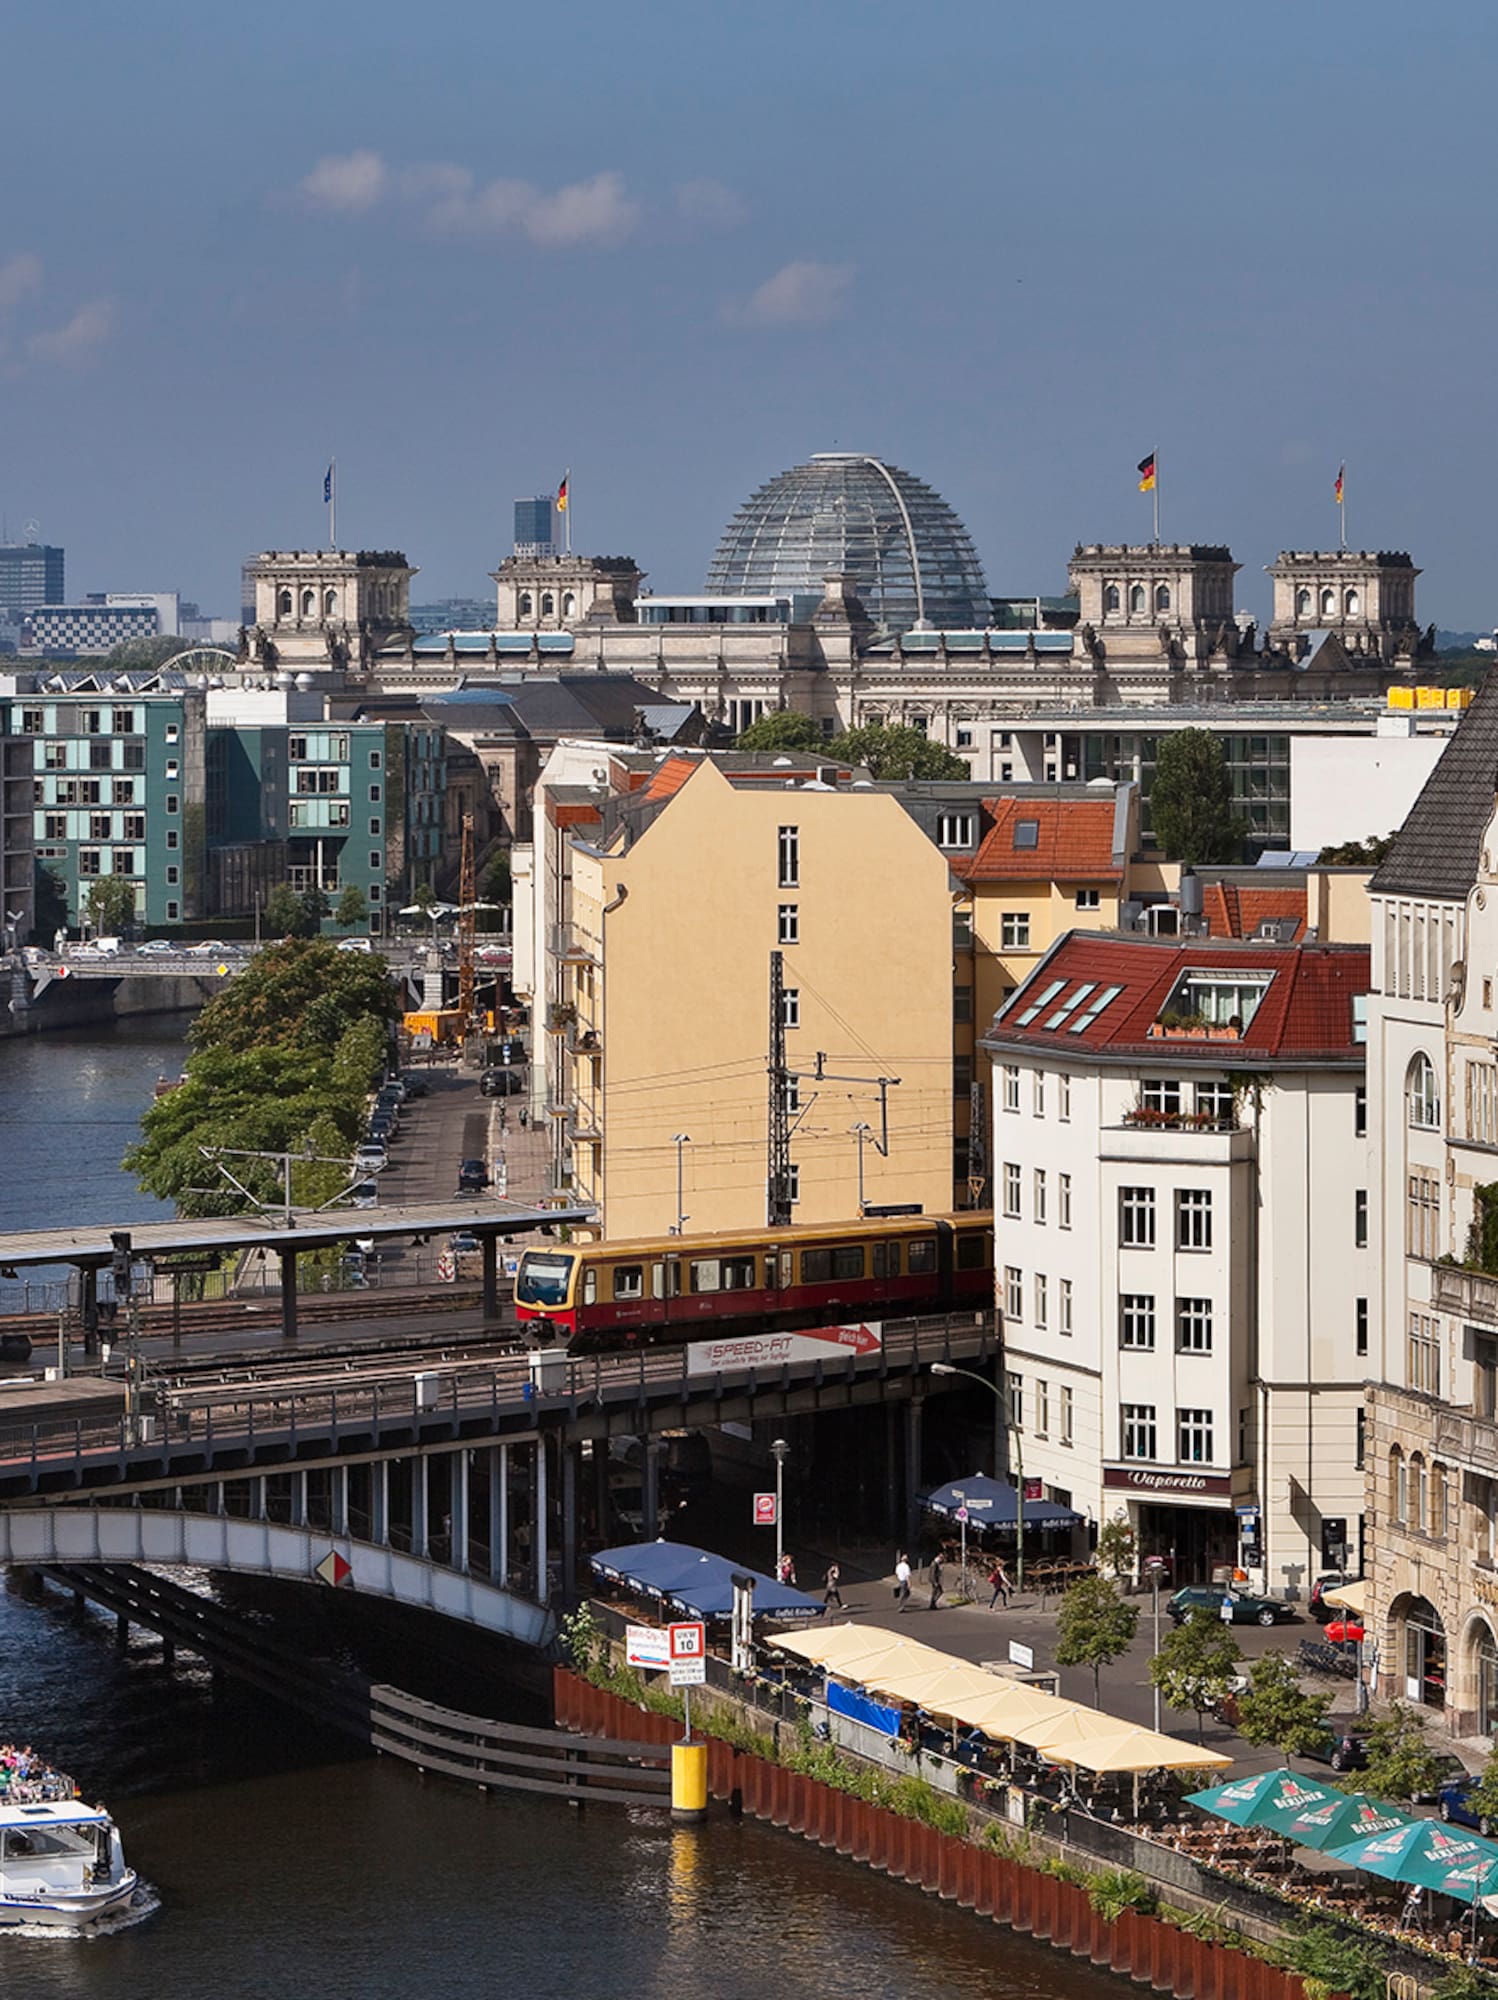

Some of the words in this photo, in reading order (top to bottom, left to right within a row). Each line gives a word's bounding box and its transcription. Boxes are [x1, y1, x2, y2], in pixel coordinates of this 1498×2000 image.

[712, 1337, 793, 1358] SPEED-FIT
[1128, 1471, 1206, 1489] Vaporetto
[681, 1640, 694, 1651] 10
[1423, 1841, 1479, 1861] BERLINER
